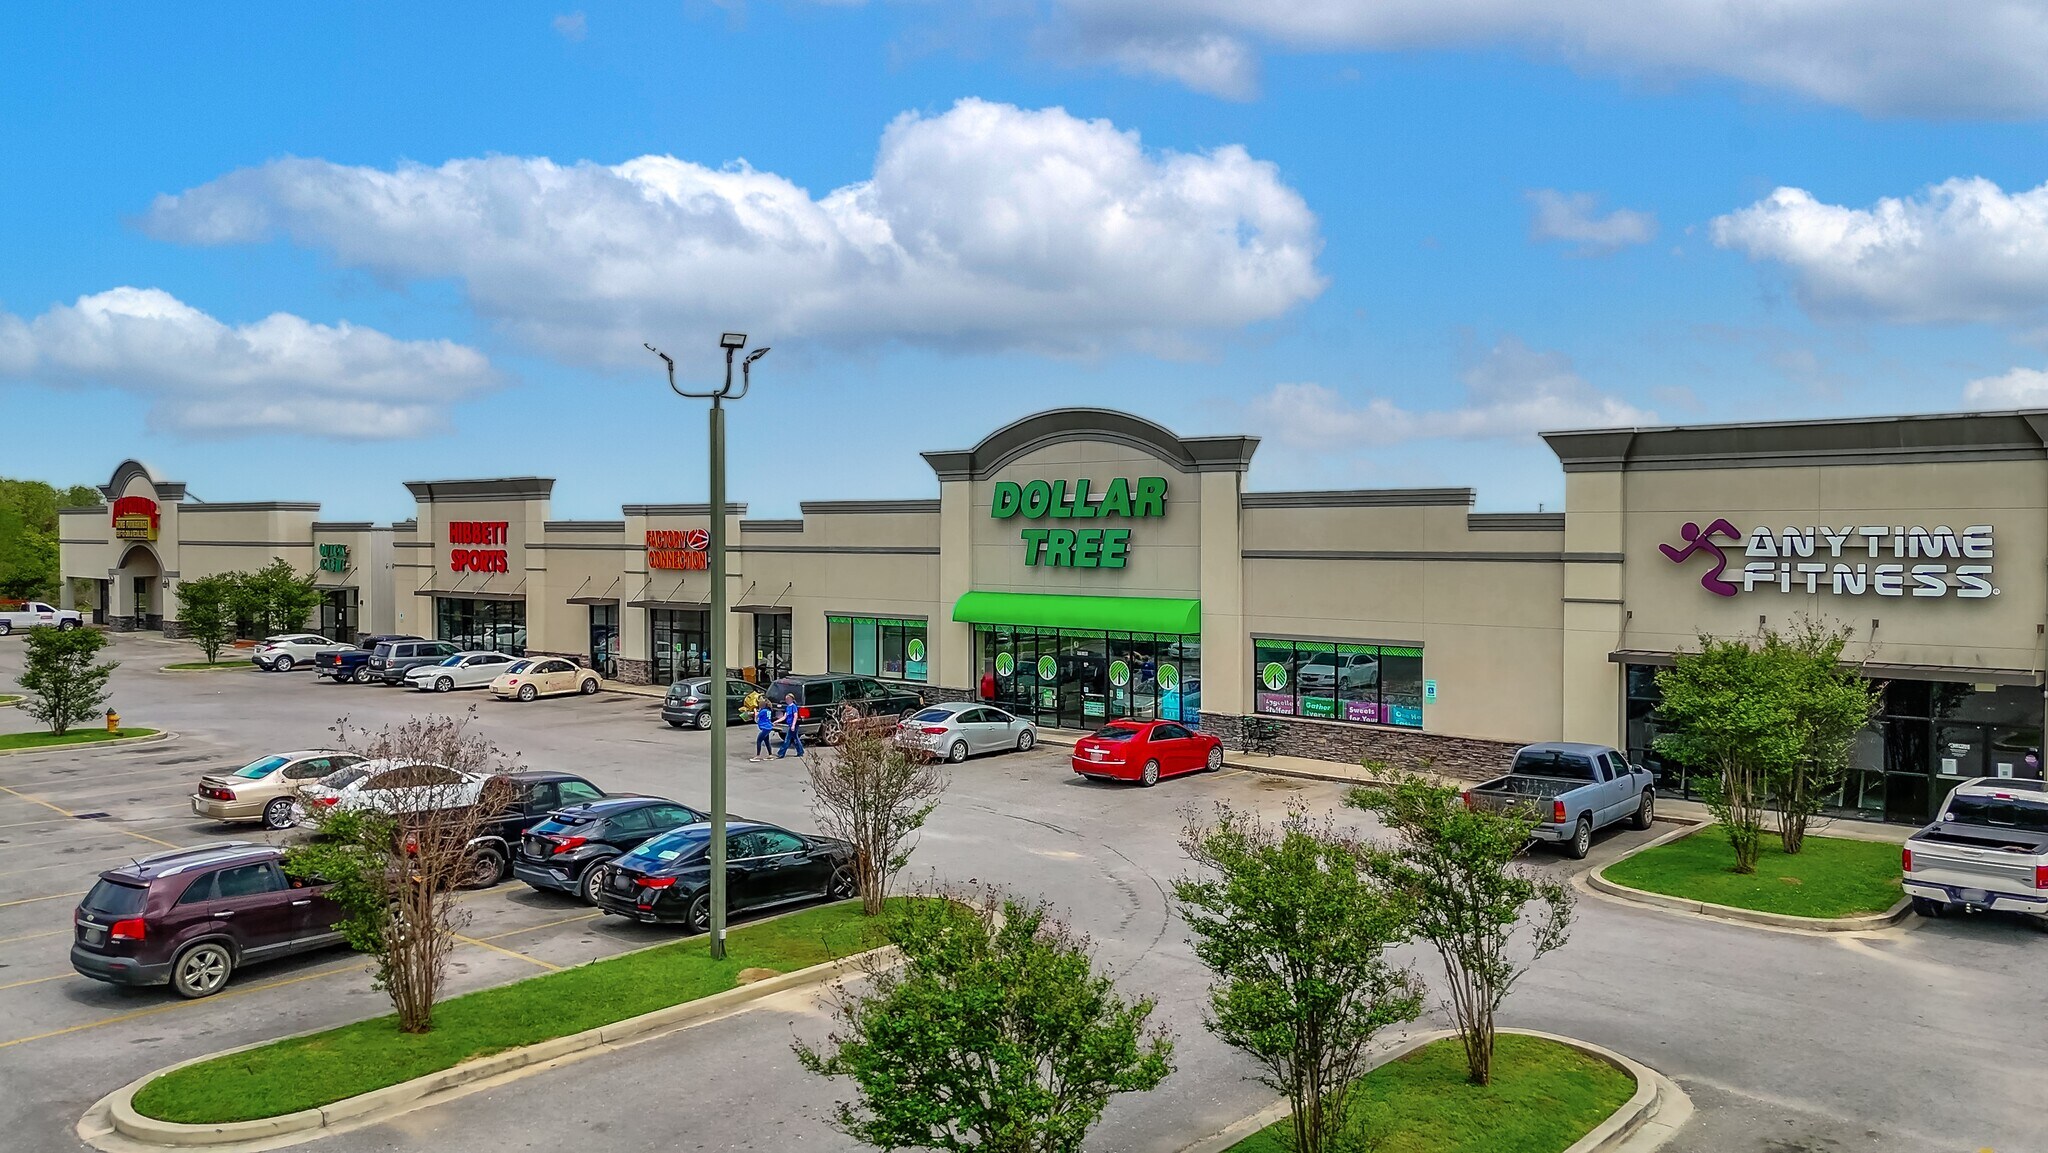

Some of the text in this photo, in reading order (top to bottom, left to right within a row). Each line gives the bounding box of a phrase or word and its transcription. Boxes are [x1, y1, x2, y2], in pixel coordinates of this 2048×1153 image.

[991, 477, 1168, 519] DOLLAR
[449, 521, 509, 545] HIBBETT
[646, 529, 687, 549] FACTORY
[1744, 525, 1994, 558] ANYTIME
[648, 549, 708, 570] CONNECTION
[1021, 528, 1131, 568] TREE
[451, 549, 508, 573] SPORTS
[1305, 702, 1331, 711] Gather
[1349, 706, 1375, 715] Sweets
